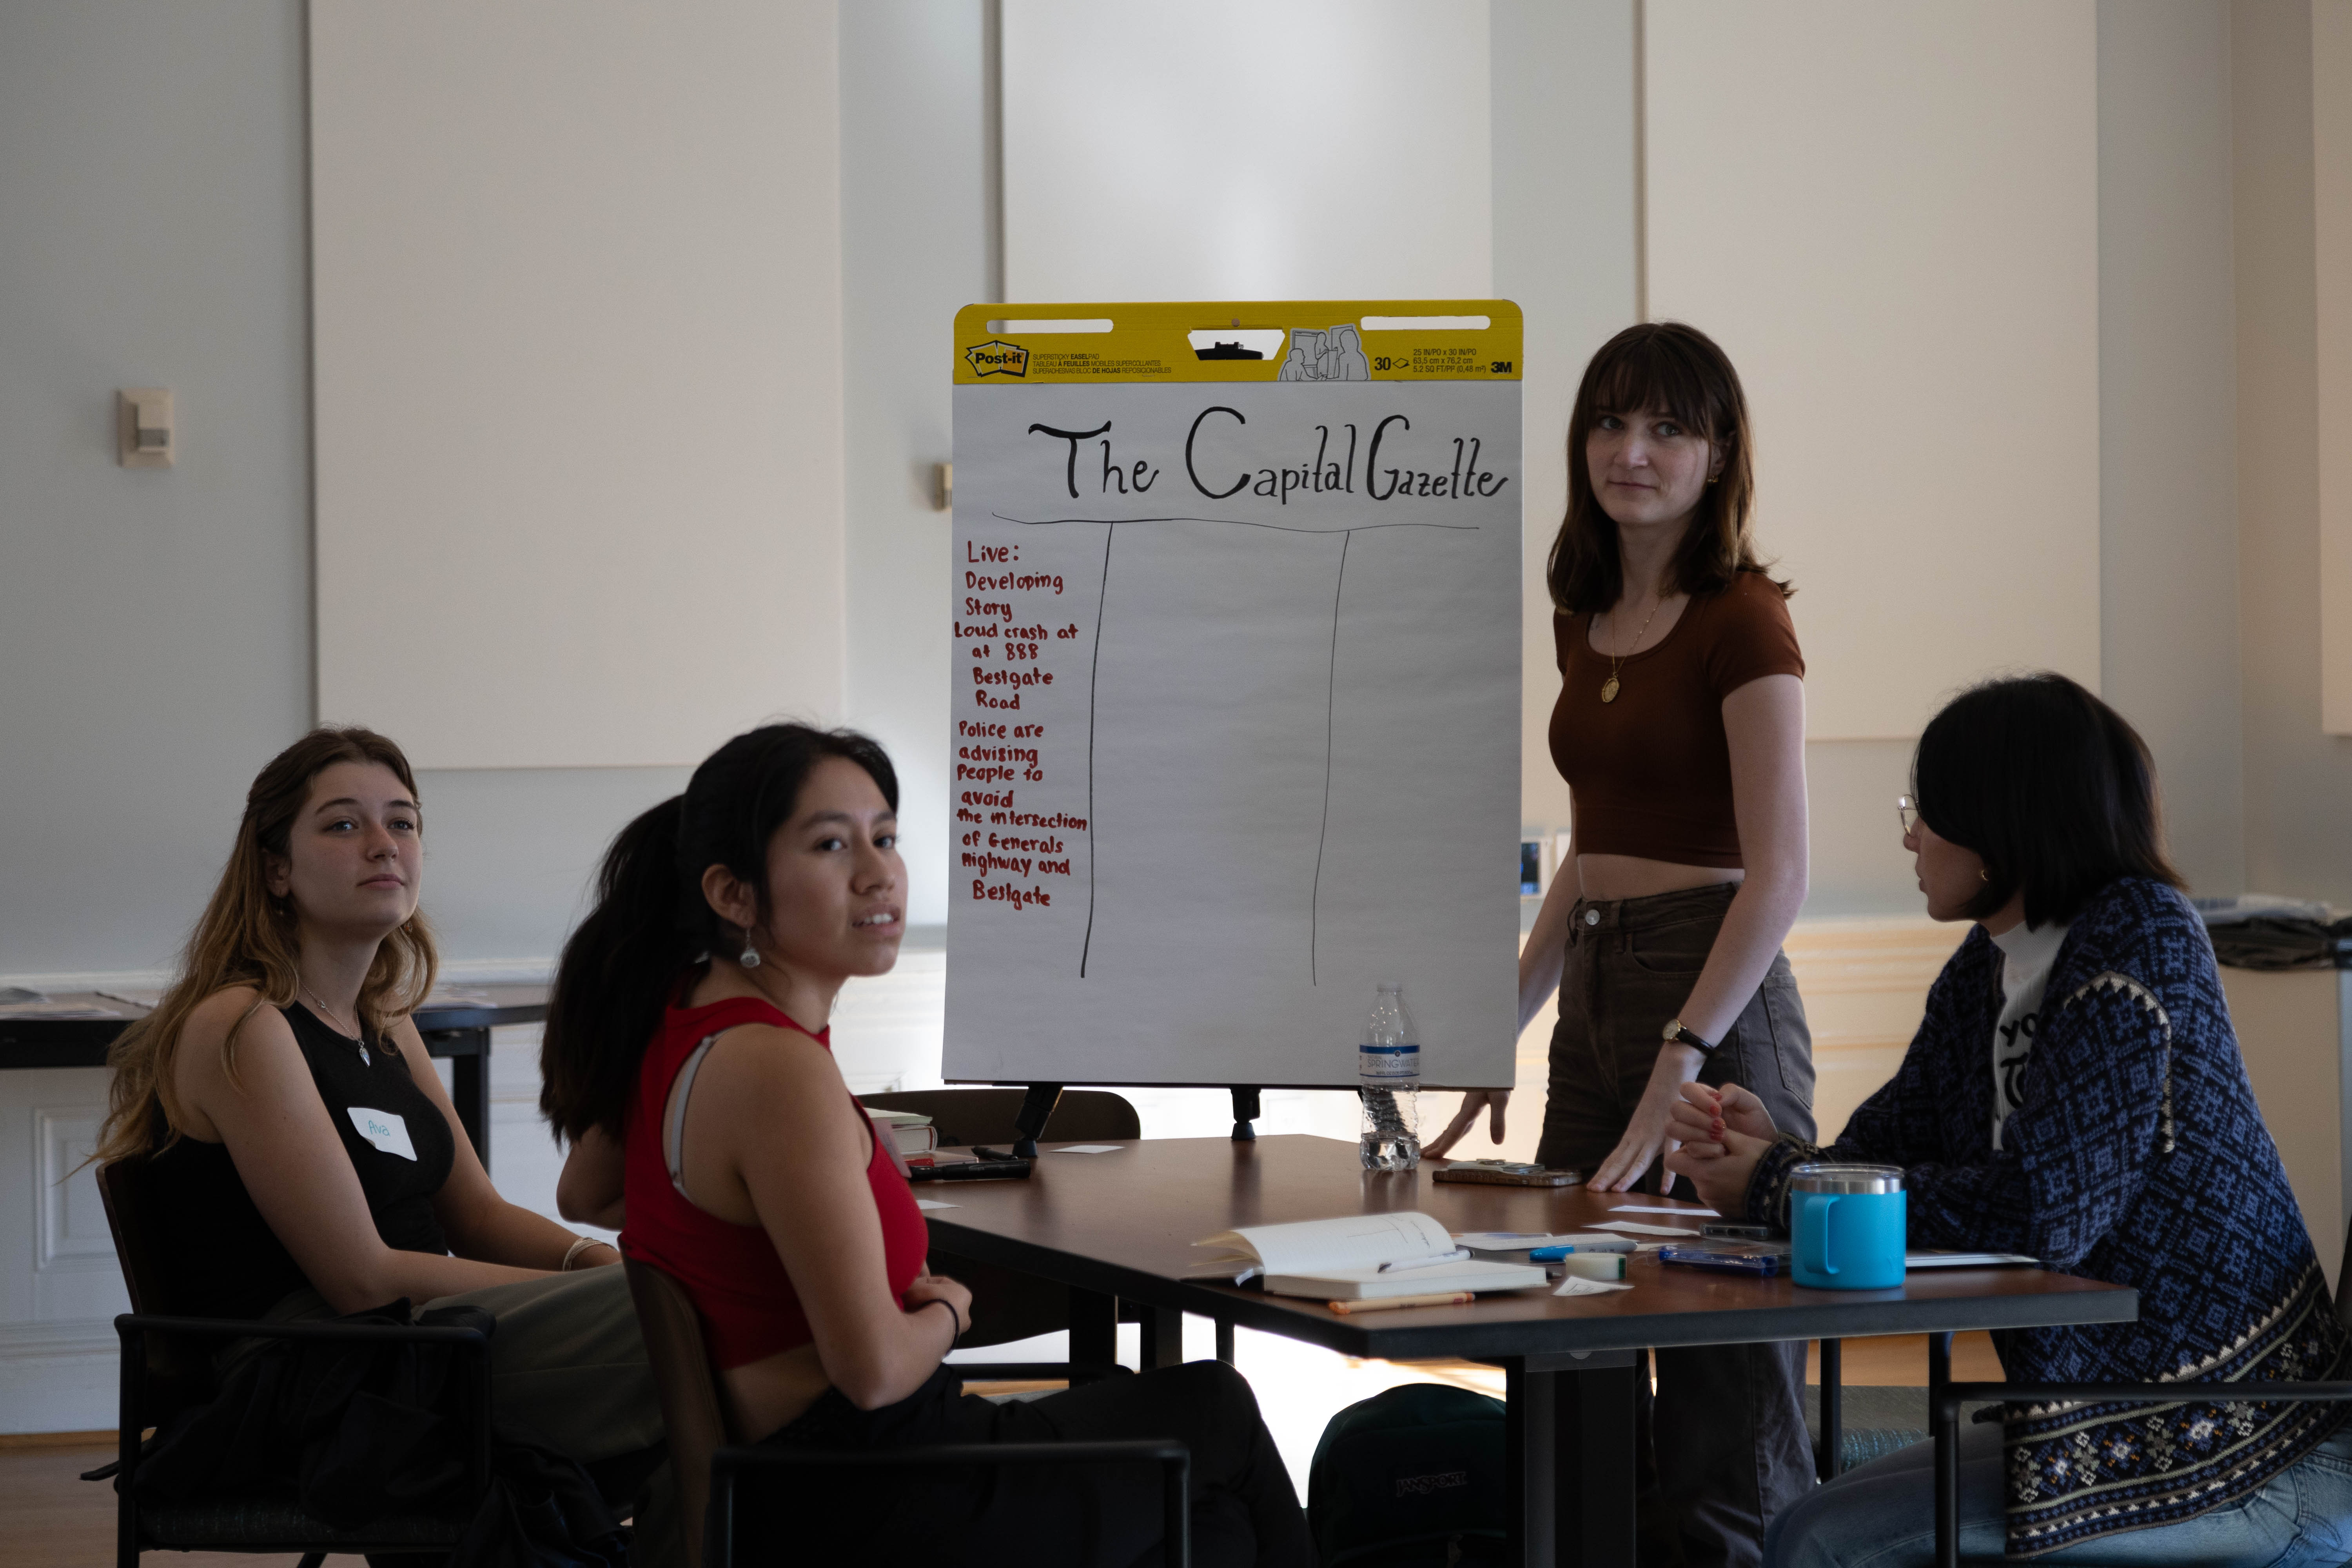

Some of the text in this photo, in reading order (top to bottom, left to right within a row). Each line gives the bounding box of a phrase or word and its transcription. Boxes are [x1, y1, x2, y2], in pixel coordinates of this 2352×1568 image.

[975, 352, 1022, 364] Post-it
[1374, 357, 1391, 370] 30
[1490, 361, 1512, 373] 3M
[1457, 365, 1474, 373] (0,48
[1028, 407, 1509, 505] The Capital Gazette
[967, 541, 1019, 563] Live:
[965, 571, 1063, 595] Developing
[965, 597, 1012, 622] Story
[955, 622, 1078, 640] Loud crash at
[972, 642, 1038, 661] at 888
[973, 667, 1053, 690] Bestgate
[976, 690, 1020, 710] Road
[959, 720, 1044, 739] Police are
[959, 745, 1038, 768] advising
[1024, 768, 1043, 781] to
[961, 790, 1014, 808] avoid
[957, 808, 1087, 831] the intersection
[962, 830, 1063, 854] of Generals
[962, 852, 1071, 877] Highway and
[973, 879, 1050, 911] Bestgate
[368, 1120, 390, 1137] Ava
[1396, 1471, 1468, 1497] JANSPORT
